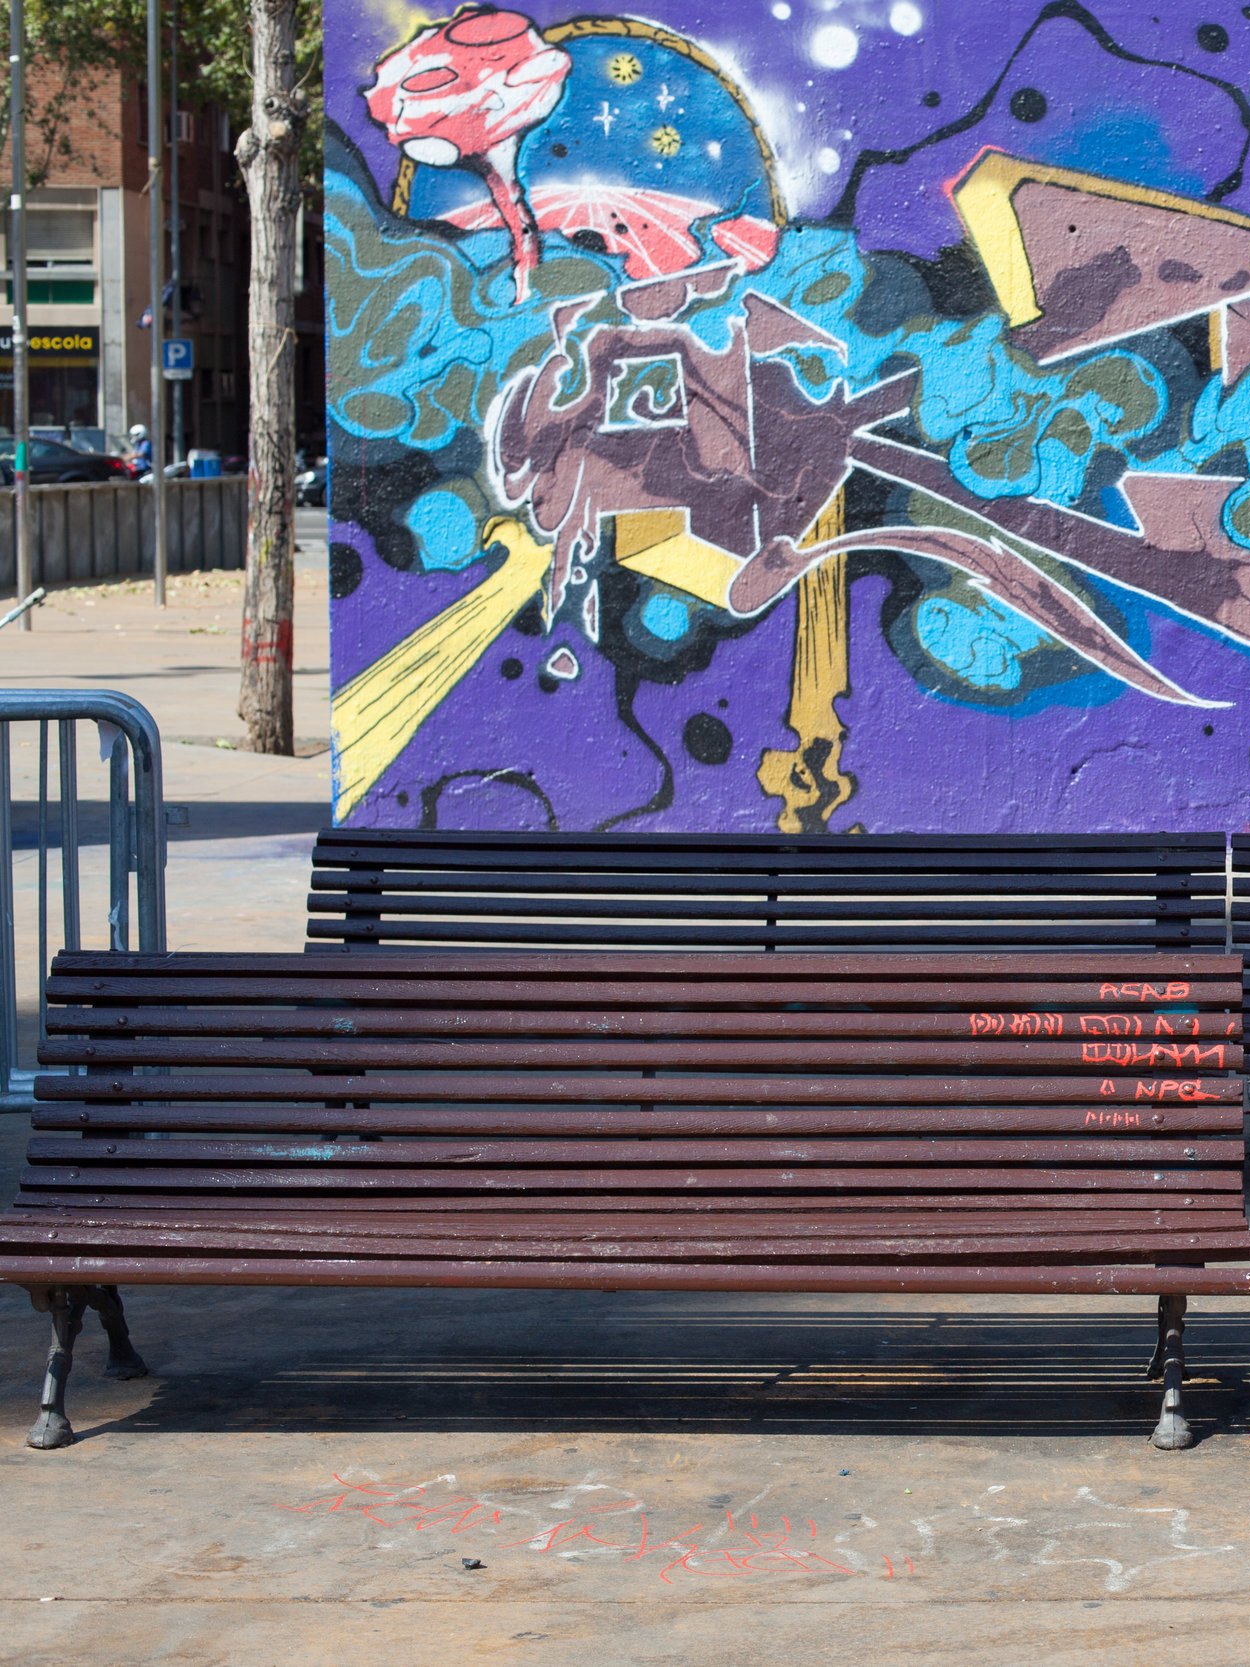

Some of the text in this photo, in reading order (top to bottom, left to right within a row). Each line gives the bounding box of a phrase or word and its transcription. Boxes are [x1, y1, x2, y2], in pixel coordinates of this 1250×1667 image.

[0, 334, 93, 350] uescola
[168, 343, 186, 366] P
[1100, 982, 1190, 1001] ACAB
